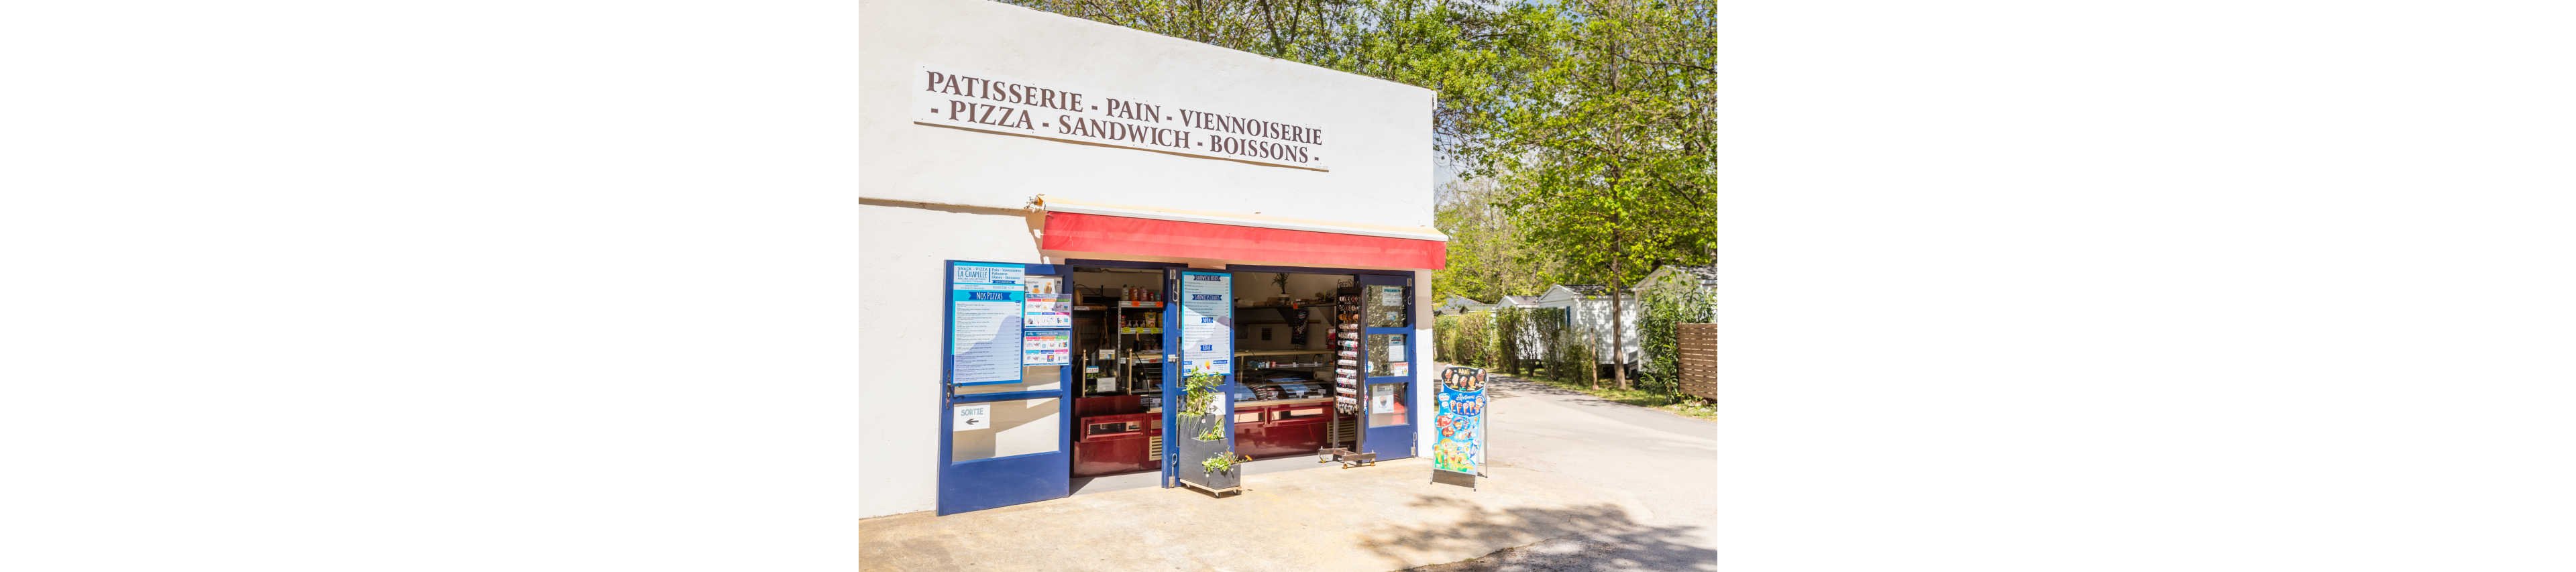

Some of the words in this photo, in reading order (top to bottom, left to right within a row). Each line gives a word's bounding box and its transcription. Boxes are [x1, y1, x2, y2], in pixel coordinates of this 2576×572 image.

[926, 70, 1083, 113] PATISSERIE
[1106, 98, 1161, 123] PAIN
[1179, 109, 1322, 146] VIENNOISERIE
[949, 99, 1034, 130] PIZZA
[1059, 115, 1190, 149] SANDWICH
[1210, 134, 1308, 164] BOISSONS
[987, 292, 1003, 300] PIZZAS
[960, 407, 984, 416] SORTIE
